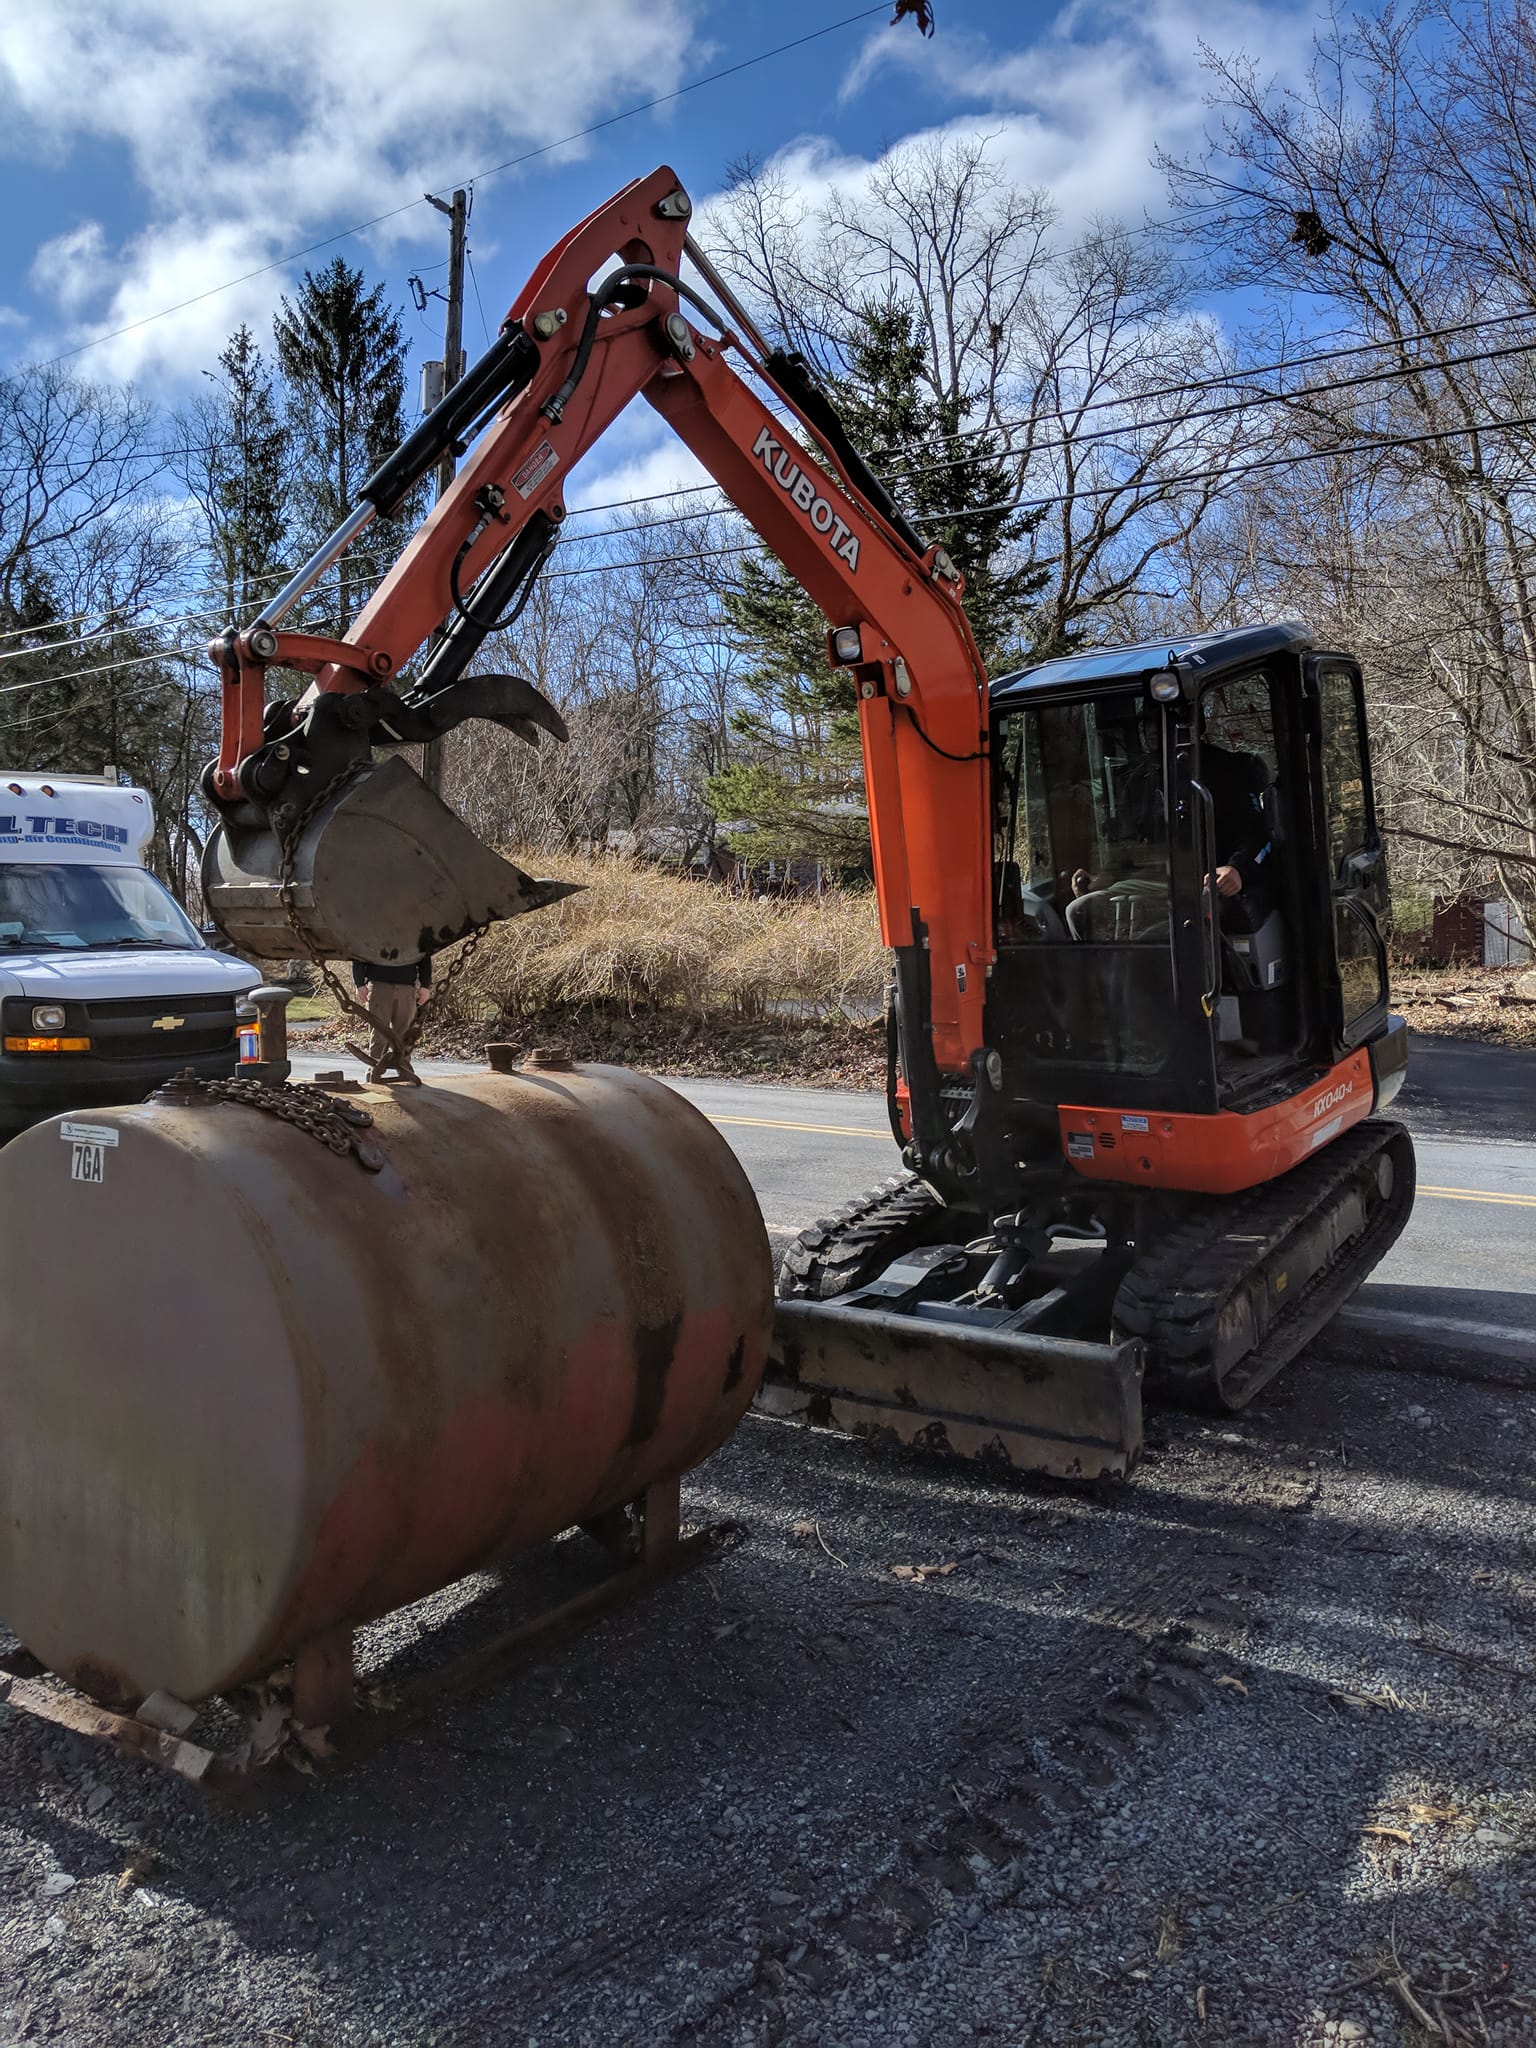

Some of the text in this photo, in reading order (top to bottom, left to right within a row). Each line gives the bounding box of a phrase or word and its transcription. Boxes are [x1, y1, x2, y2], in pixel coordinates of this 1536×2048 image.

[751, 425, 861, 573] KUBOTA
[25, 815, 129, 845] TECH
[1314, 1080, 1354, 1119] KX040-4
[75, 1145, 101, 1182] 7GA
